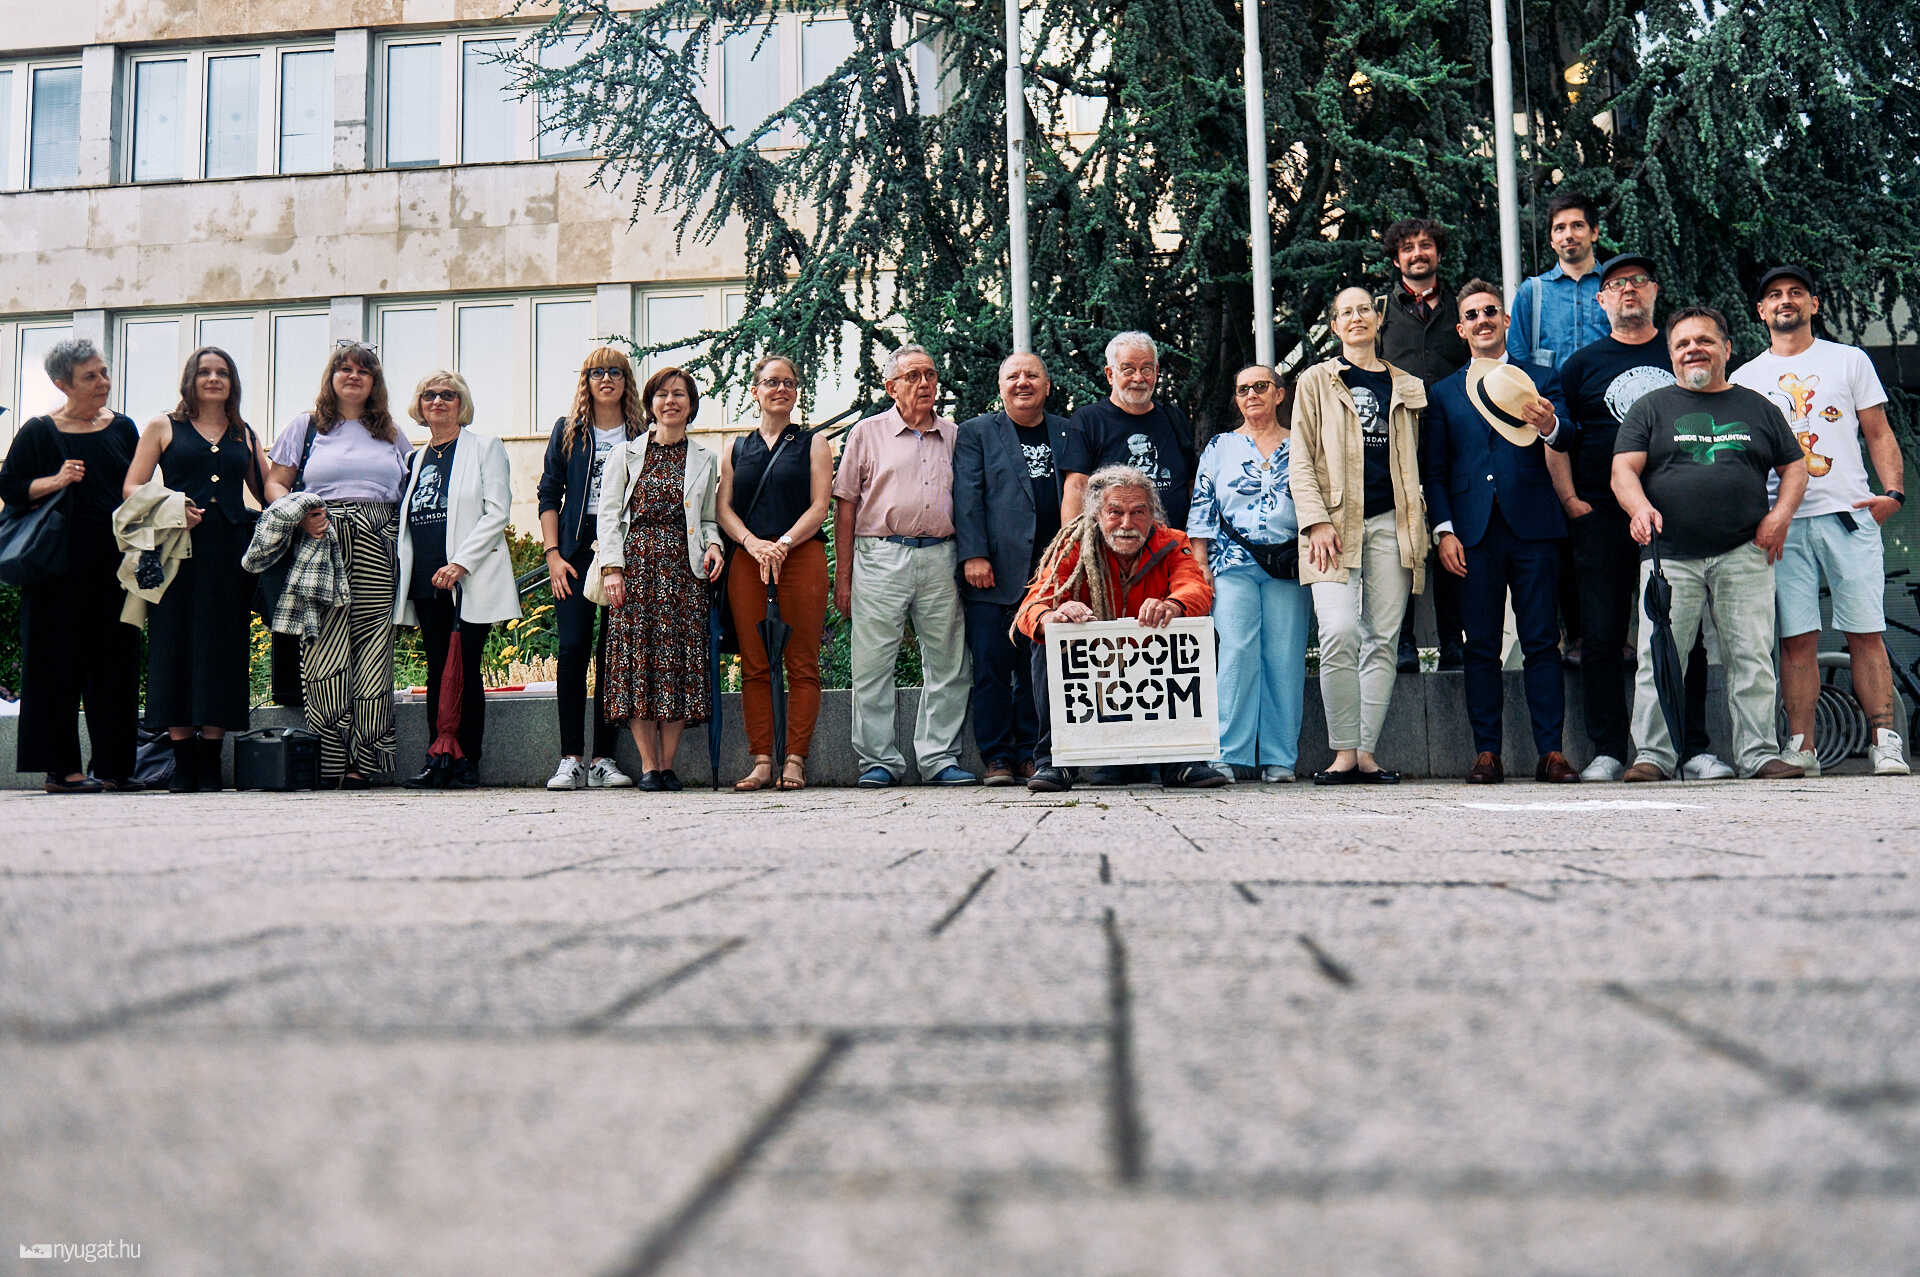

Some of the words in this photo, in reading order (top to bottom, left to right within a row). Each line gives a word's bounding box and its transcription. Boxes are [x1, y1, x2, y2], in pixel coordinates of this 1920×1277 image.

[1698, 435, 1712, 443] THE
[1713, 434, 1751, 443] MOUNTAIN
[1060, 633, 1200, 680] LEOPOLD
[1064, 676, 1203, 723] BLOOM
